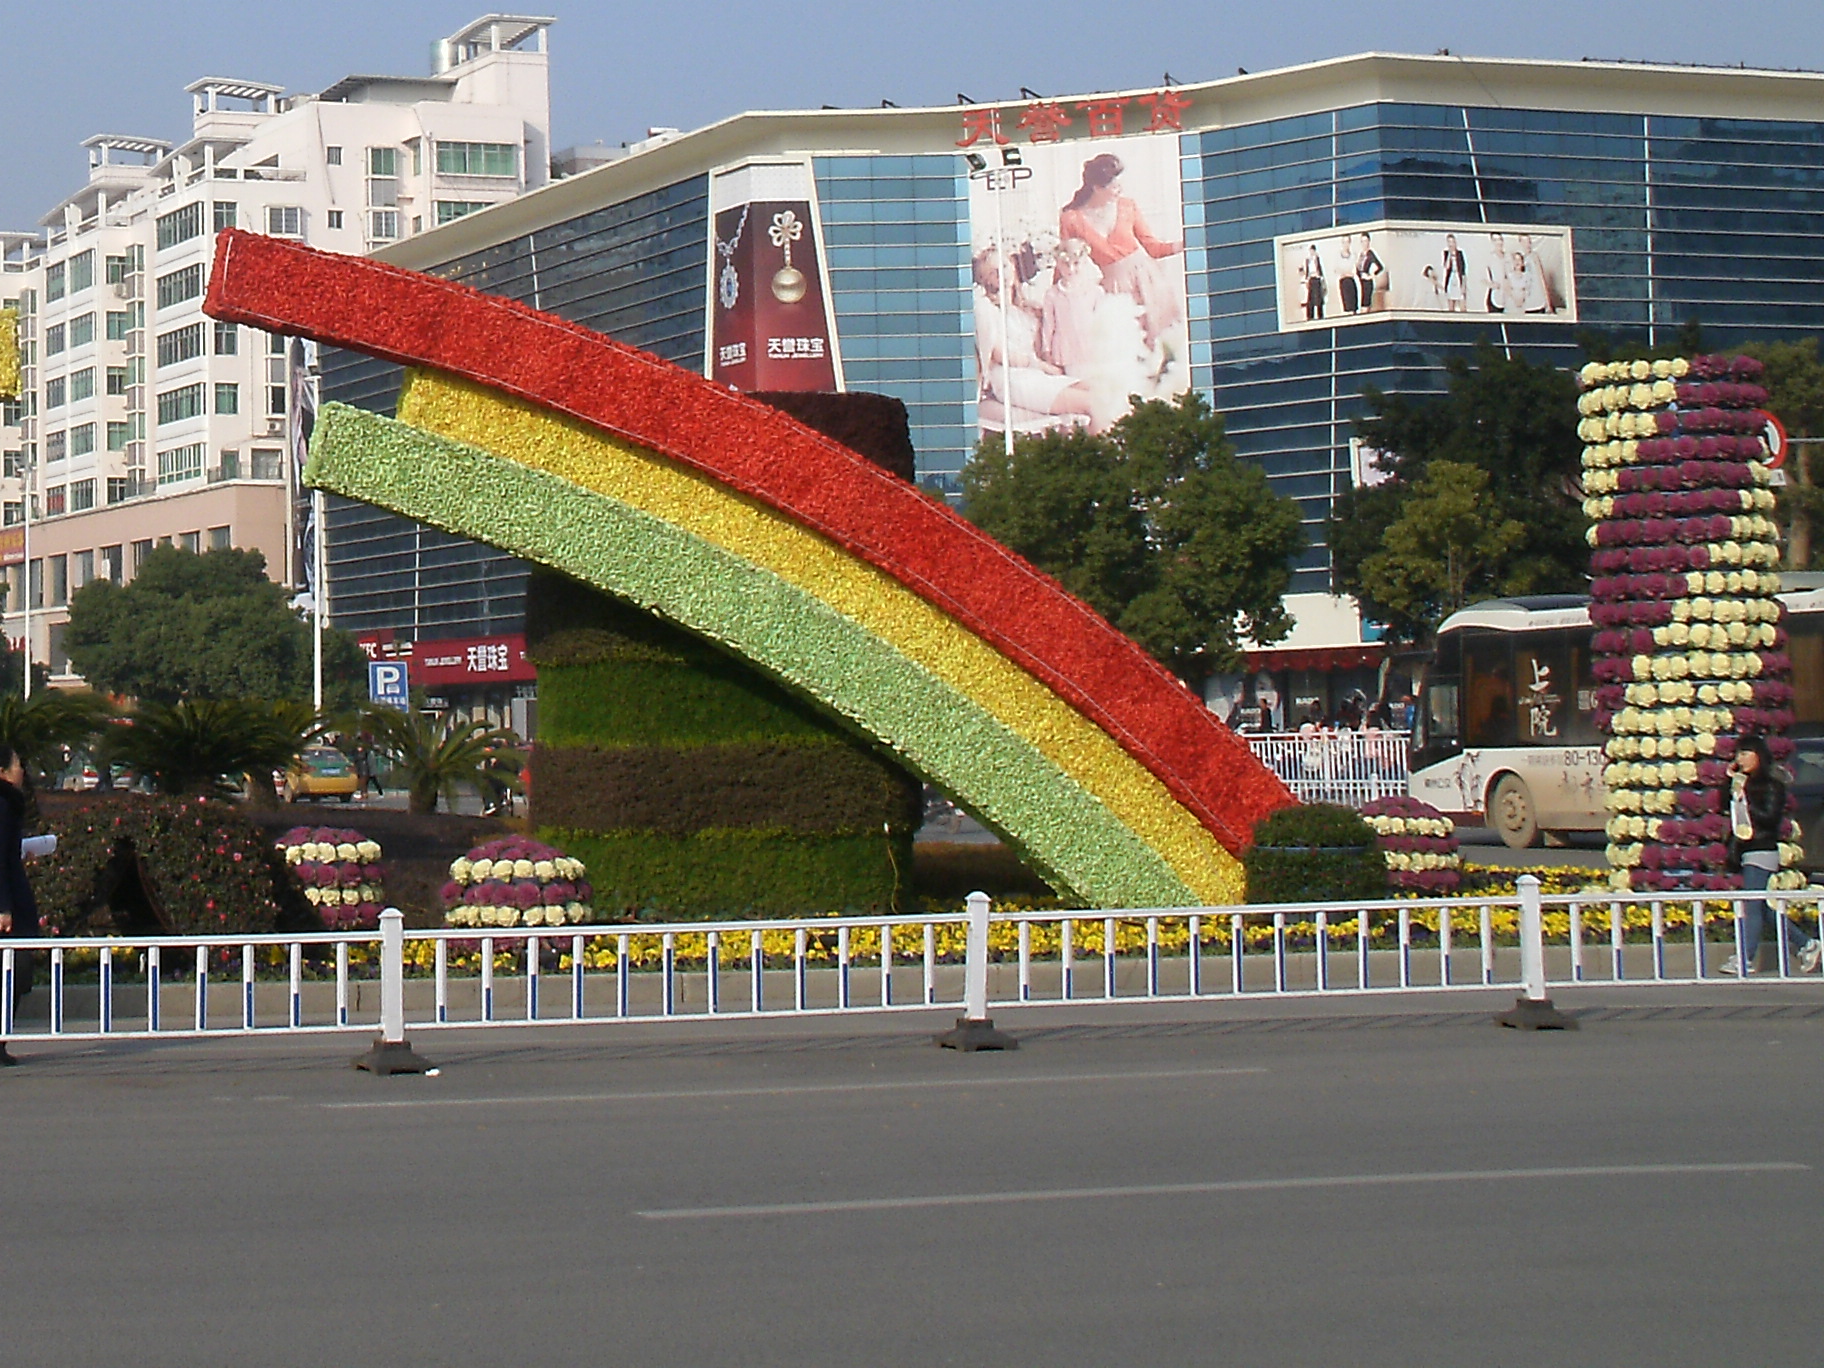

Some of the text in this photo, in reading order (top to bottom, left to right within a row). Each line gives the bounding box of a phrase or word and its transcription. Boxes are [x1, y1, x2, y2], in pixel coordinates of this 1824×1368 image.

[955, 89, 1194, 148] 天誉百货
[767, 337, 824, 353] 天誉珠宝
[376, 666, 400, 695] P
[1528, 658, 1558, 737] 上院
